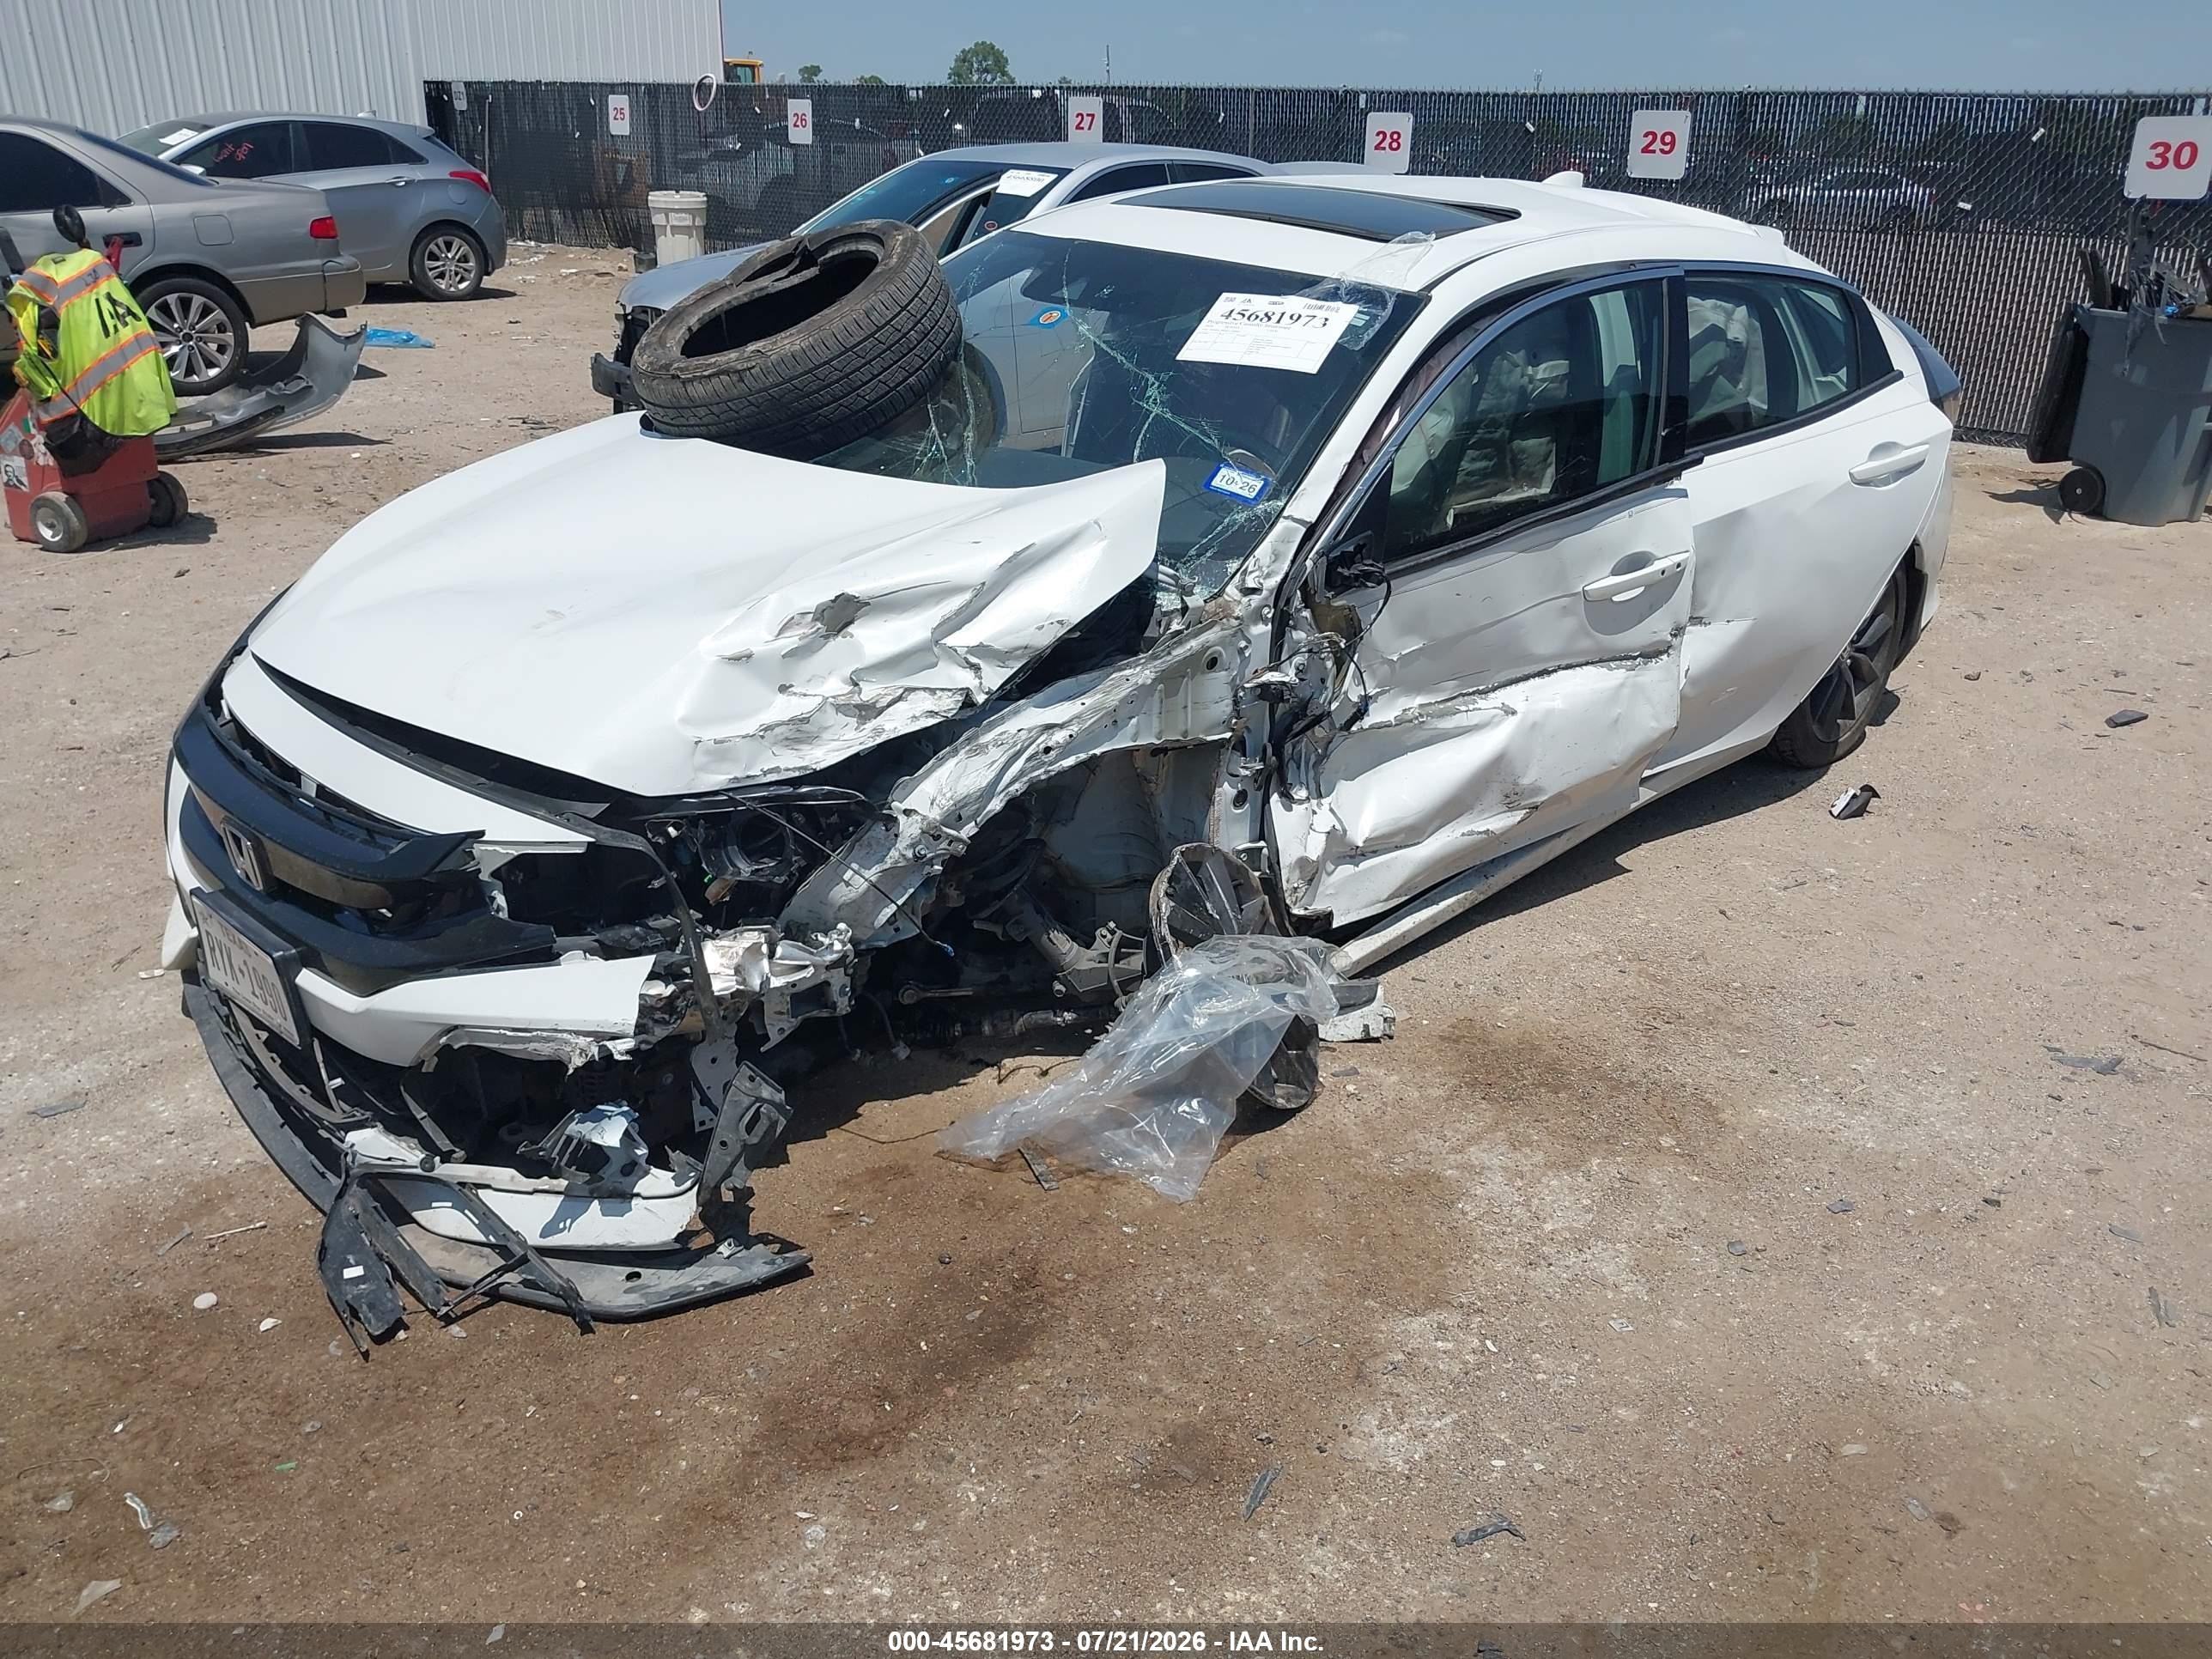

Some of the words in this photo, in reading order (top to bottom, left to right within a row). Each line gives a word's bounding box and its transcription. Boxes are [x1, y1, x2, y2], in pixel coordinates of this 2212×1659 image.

[613, 106, 625, 121] 25
[793, 112, 807, 129] 26
[1075, 112, 1096, 131] 27
[1374, 130, 1401, 152] 28
[1640, 131, 1676, 155] 29
[2145, 141, 2198, 170] 30
[1220, 307, 1329, 329] 45681973
